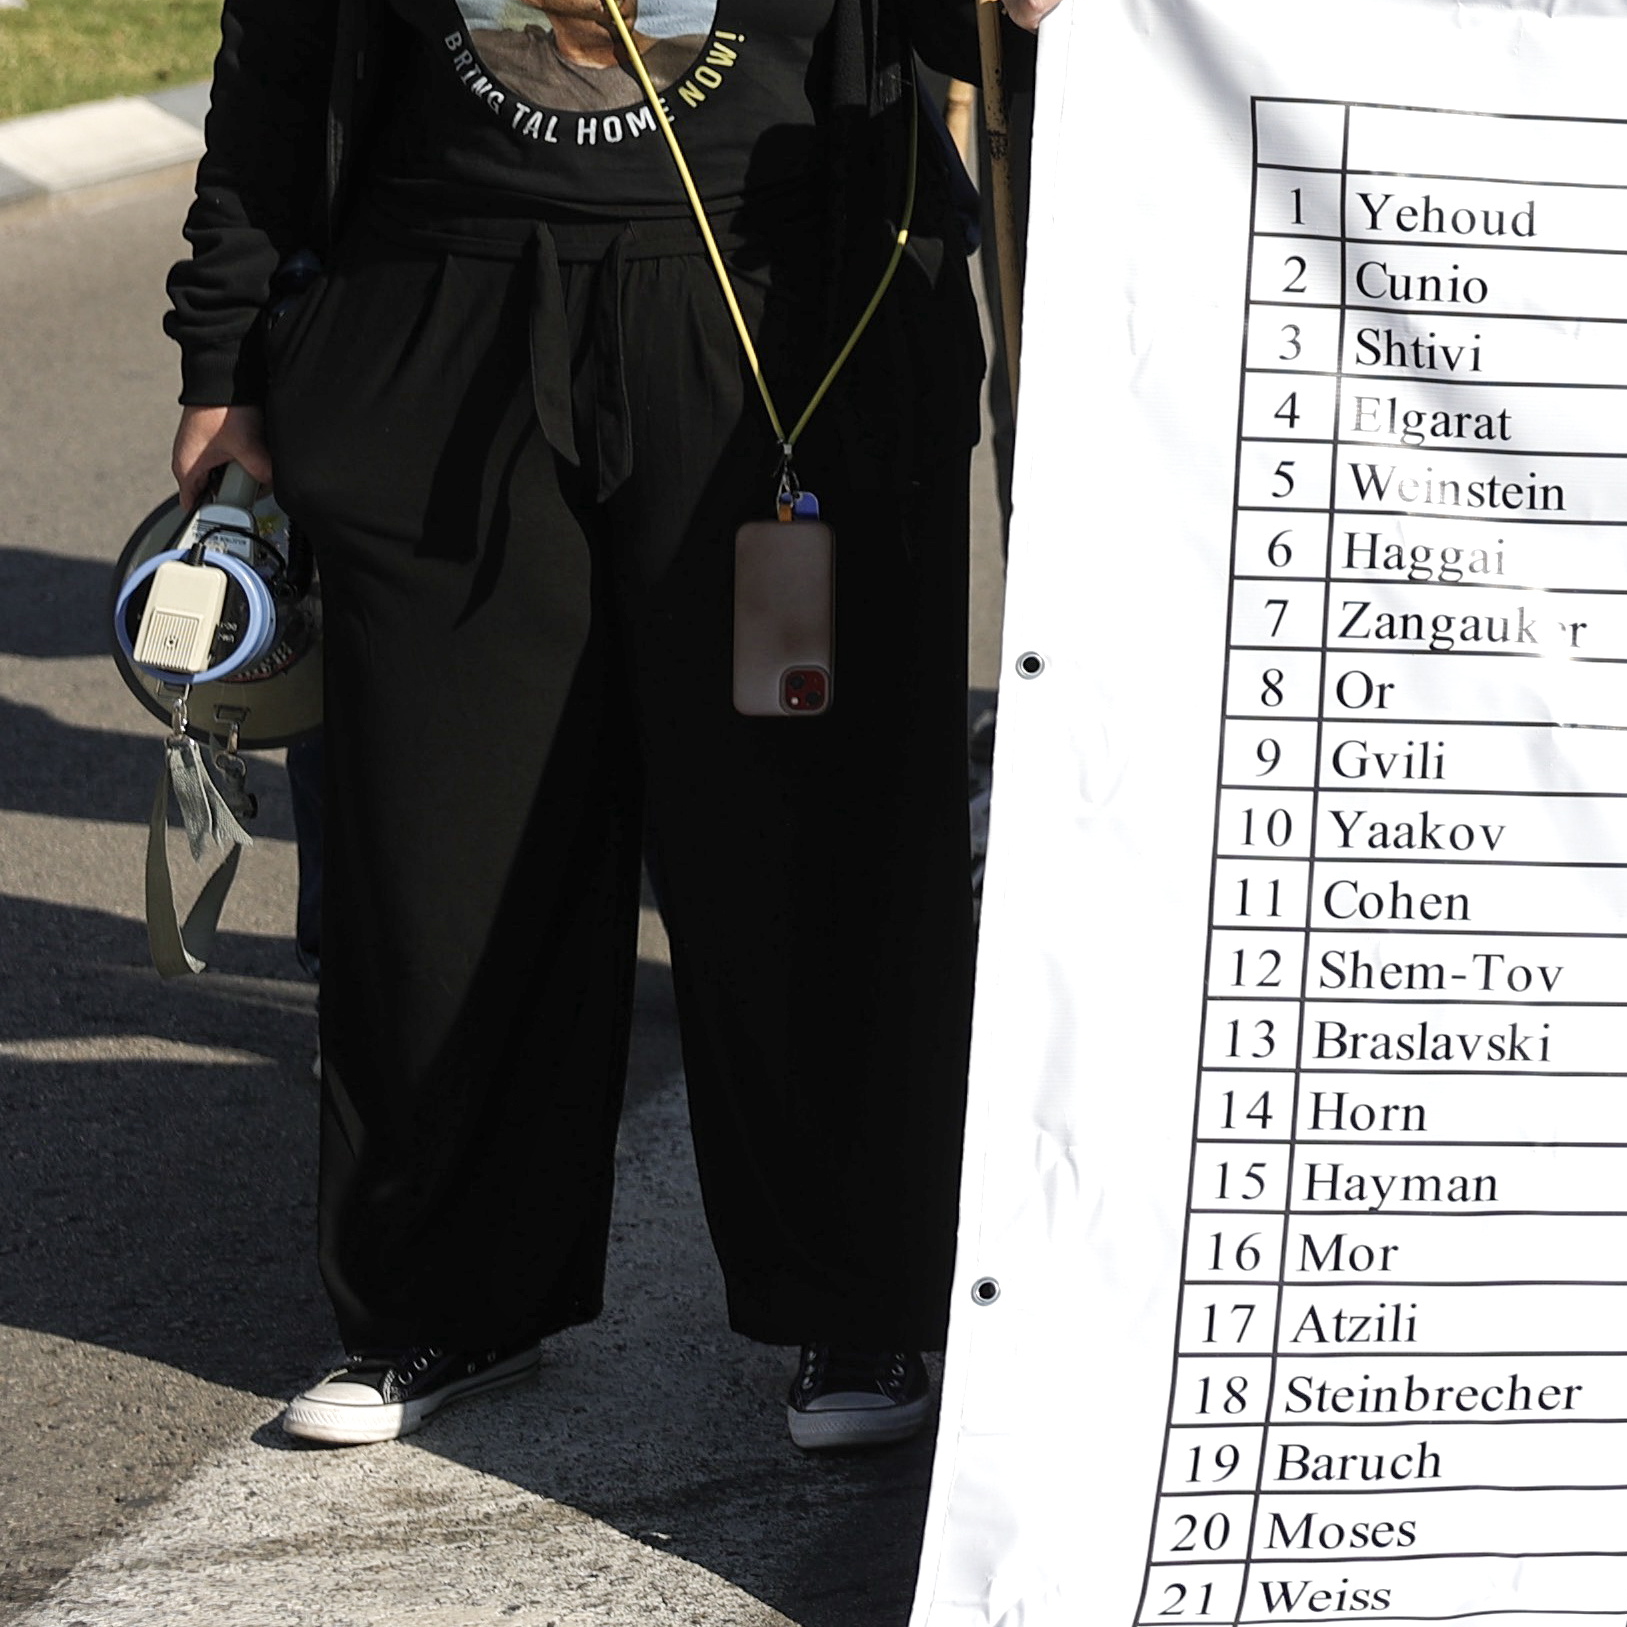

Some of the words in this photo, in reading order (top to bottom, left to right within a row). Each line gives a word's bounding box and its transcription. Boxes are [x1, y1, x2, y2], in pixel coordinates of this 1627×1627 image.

[444, 31, 504, 115] BRING
[511, 101, 558, 143] TAL
[678, 29, 745, 108] NOW!
[1290, 188, 1306, 226] 1
[1356, 193, 1537, 237] Yehoud
[1232, 949, 1282, 987] 12
[1319, 950, 1564, 992] Shem-Tov
[1207, 1232, 1262, 1271] 16
[1297, 1233, 1398, 1272] Mor
[1195, 1376, 1248, 1415] 18
[1285, 1374, 1583, 1414] Steinbrecher
